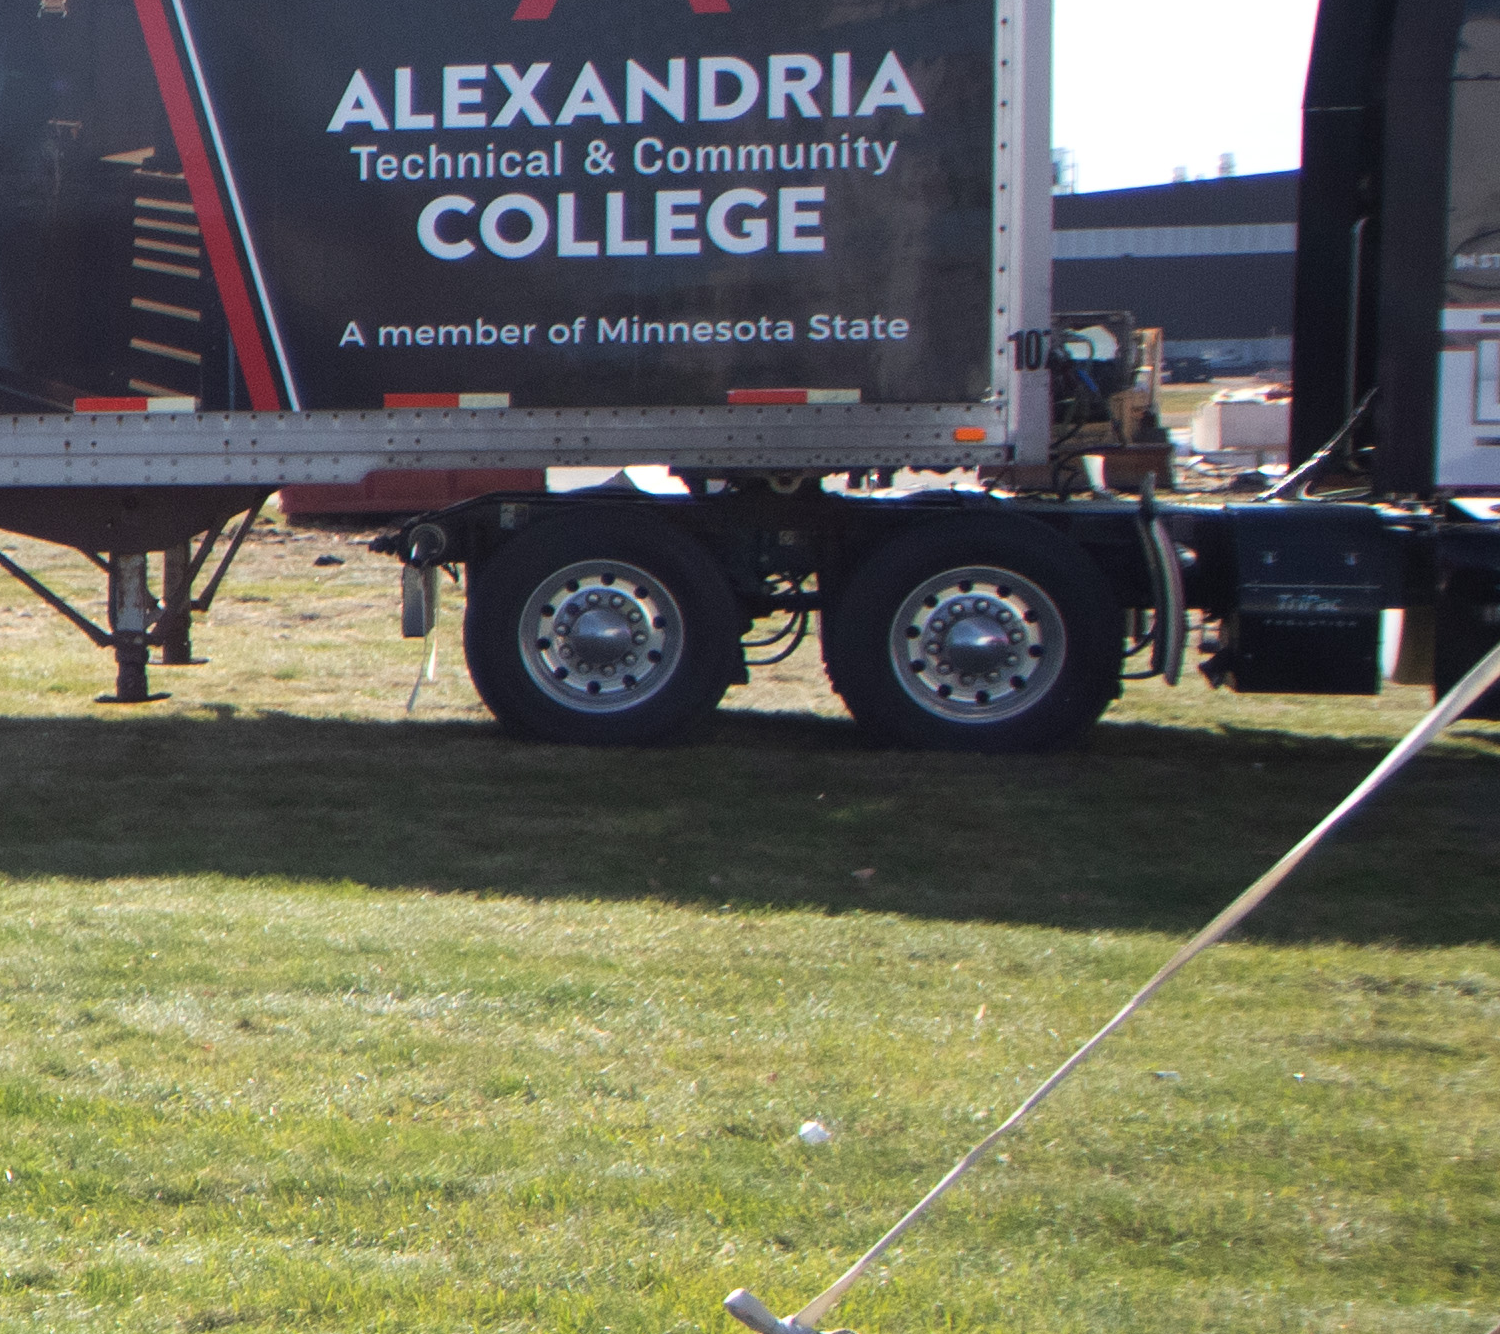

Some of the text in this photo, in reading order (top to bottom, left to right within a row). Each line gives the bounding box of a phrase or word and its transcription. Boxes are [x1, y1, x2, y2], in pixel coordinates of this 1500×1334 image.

[325, 49, 926, 134] ALEXANDRIA
[349, 132, 899, 181] Technical & Community
[416, 186, 827, 261] COLLEGE
[339, 314, 910, 348] A member of Minnesota State
